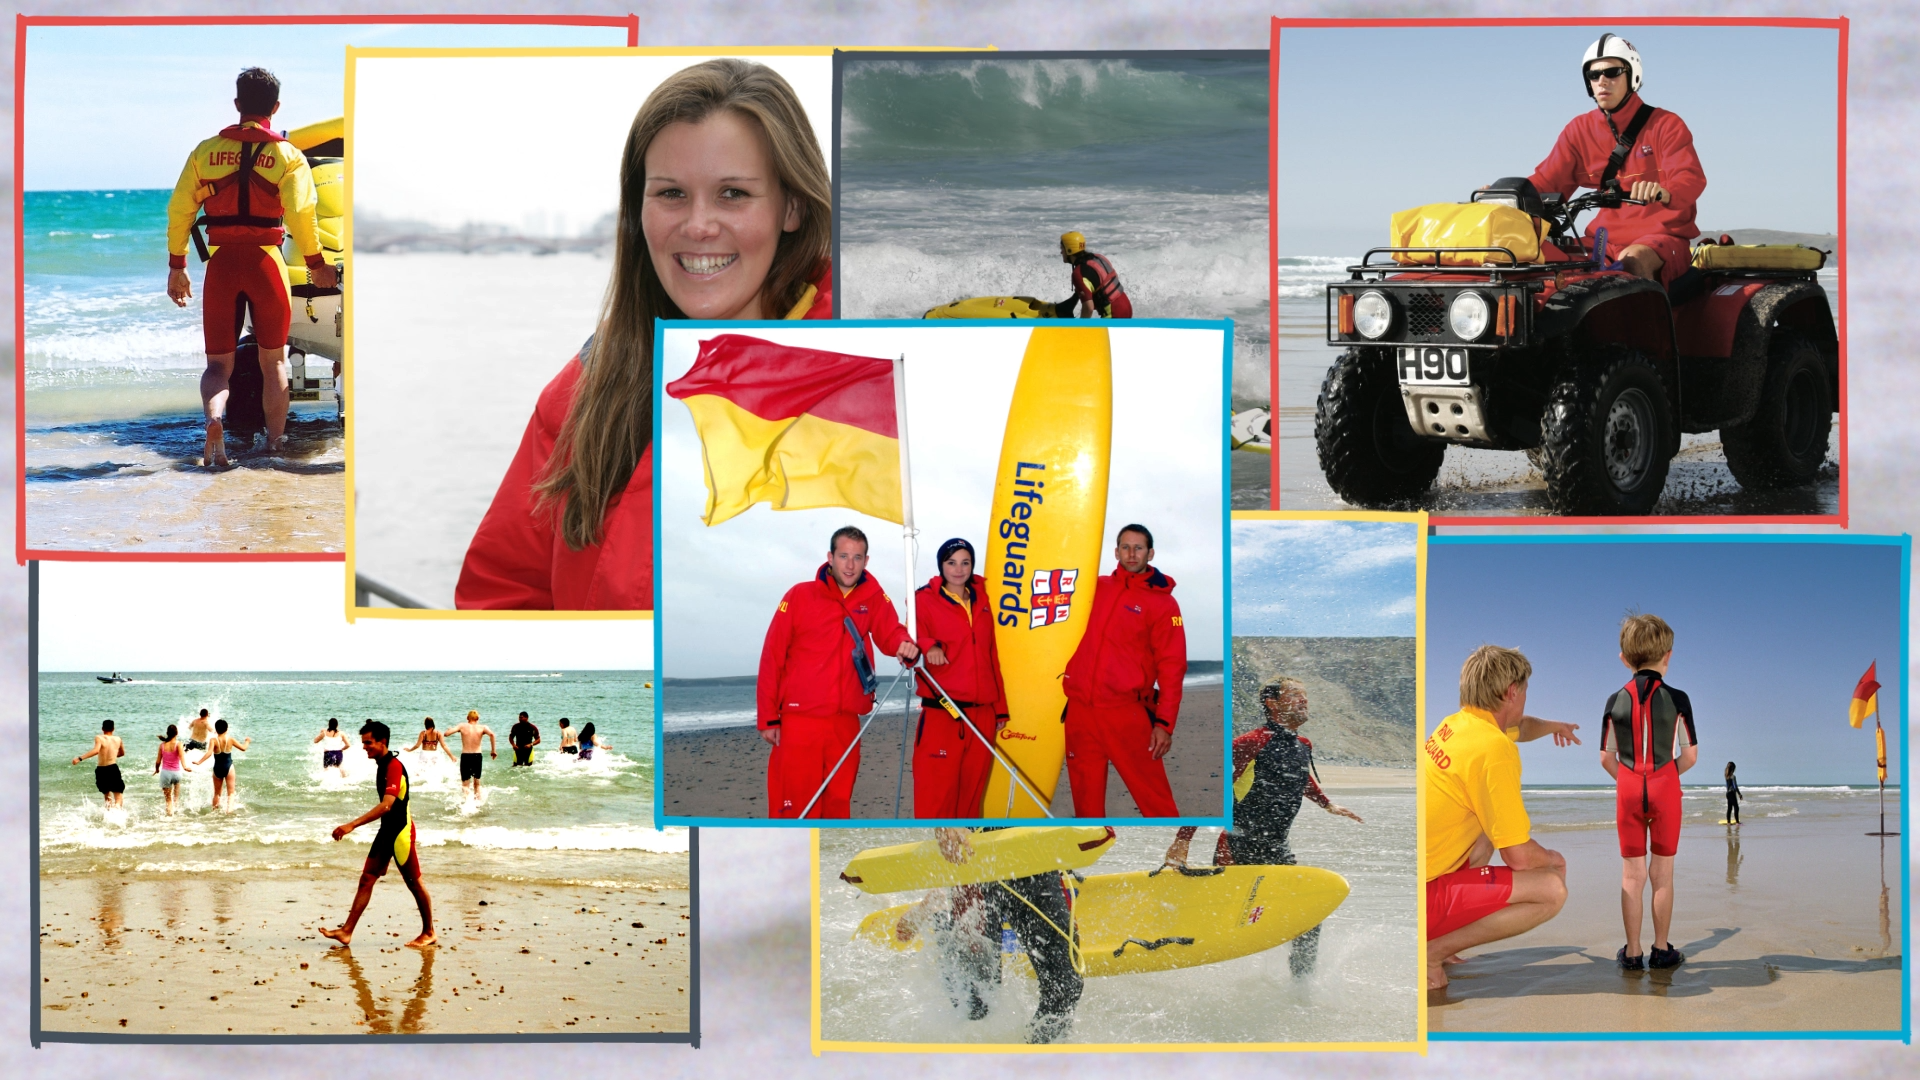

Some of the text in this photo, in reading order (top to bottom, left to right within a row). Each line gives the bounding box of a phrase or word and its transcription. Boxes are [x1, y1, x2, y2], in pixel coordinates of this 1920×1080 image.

[209, 151, 276, 169] LIFEGRD
[1399, 347, 1467, 380] H90
[998, 461, 1046, 627] Lifeguards
